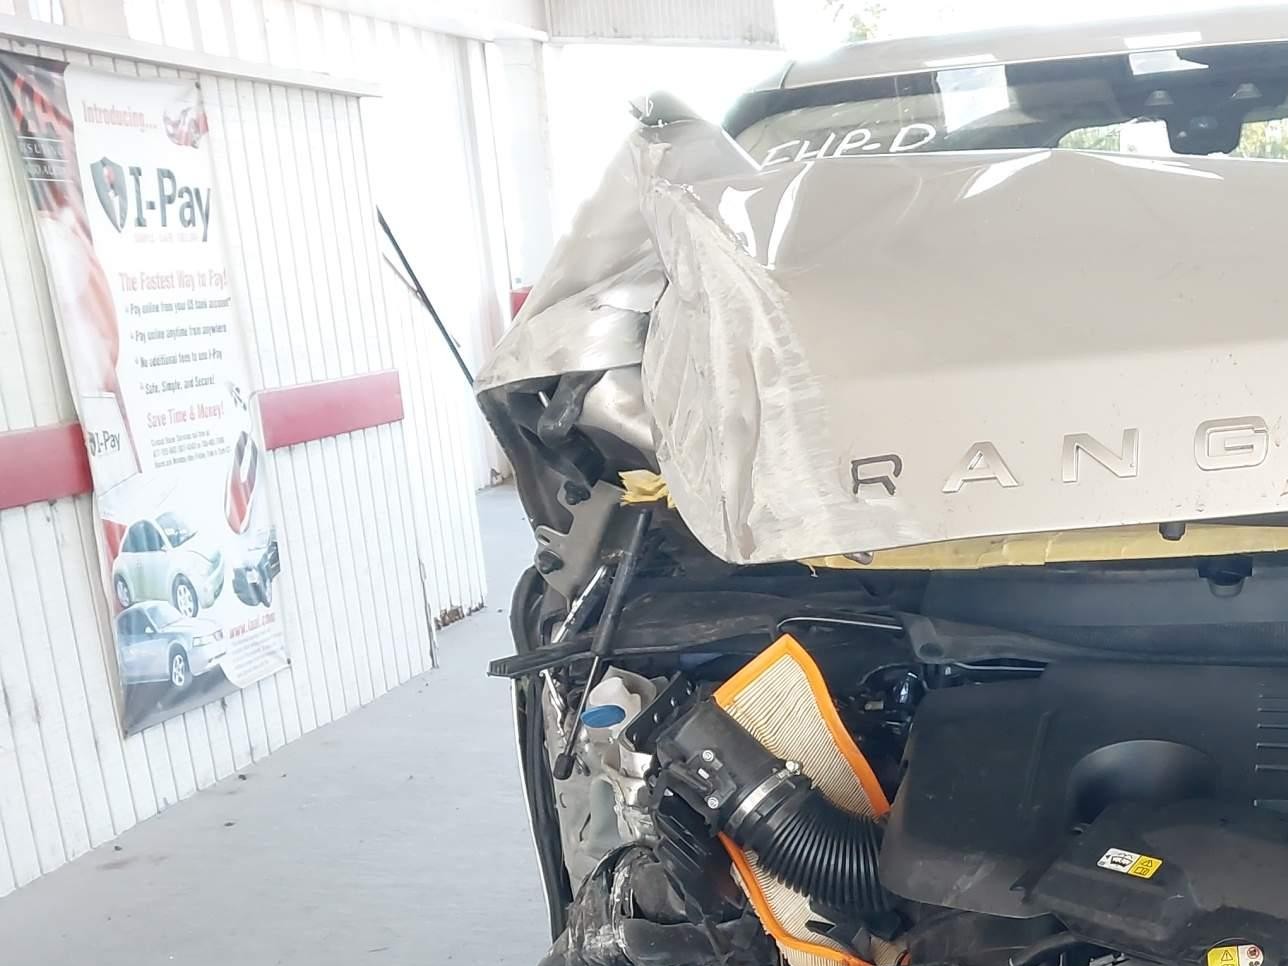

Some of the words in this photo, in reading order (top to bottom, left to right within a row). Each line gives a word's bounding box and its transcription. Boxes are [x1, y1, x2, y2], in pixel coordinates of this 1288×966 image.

[129, 166, 211, 242] I-Pay
[118, 272, 137, 292] The
[140, 272, 175, 291] Fastest
[176, 270, 195, 291] Way
[197, 272, 206, 288] to
[208, 267, 228, 291] Pay!
[146, 412, 167, 429] Save
[167, 408, 187, 425] Time
[189, 405, 196, 421] &
[197, 400, 224, 420] Money!
[95, 430, 121, 454] I-Pay
